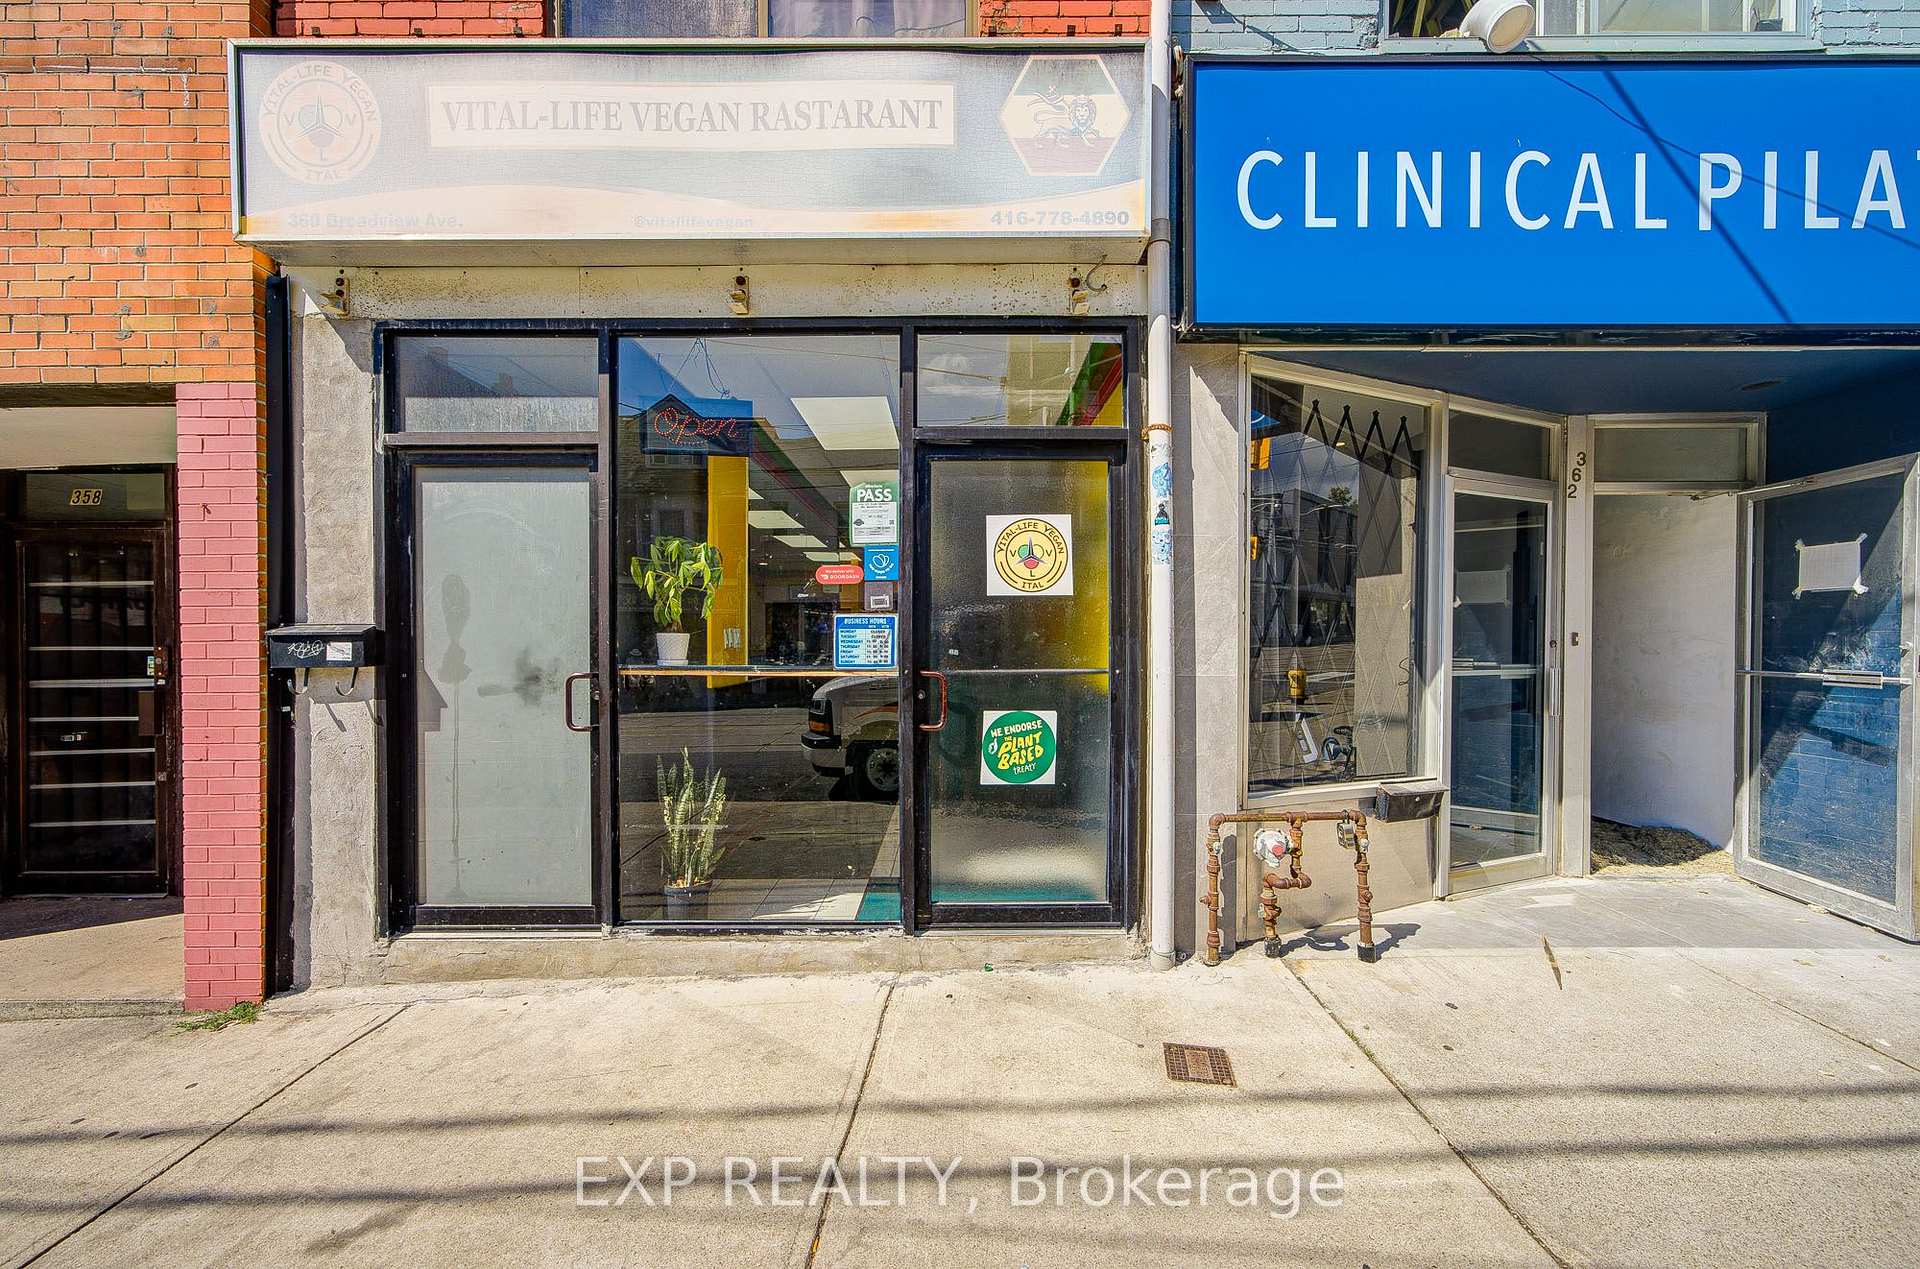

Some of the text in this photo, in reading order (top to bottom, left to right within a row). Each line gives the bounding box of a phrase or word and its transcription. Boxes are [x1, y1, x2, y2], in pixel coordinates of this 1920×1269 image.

[441, 99, 943, 133] VITAL-LIFE VEGAN RASTARANT
[1237, 149, 1920, 231] CLINICAL PILA
[326, 213, 418, 228] Broadview
[990, 211, 1130, 225] 416-778-4890
[654, 407, 738, 445] Open
[72, 490, 101, 504] 358
[856, 488, 893, 502] PASS
[997, 521, 1065, 554] VITAL-LIFE VEGAN
[1009, 549, 1017, 557] V
[1045, 549, 1052, 557] V
[1029, 569, 1036, 578] L
[1021, 581, 1045, 590] ITAL
[844, 617, 887, 625] BUSINESS HOURS
[990, 719, 1043, 738] WE ENDORSE
[997, 731, 1043, 758] PLANT
[997, 744, 1044, 770] BASED
